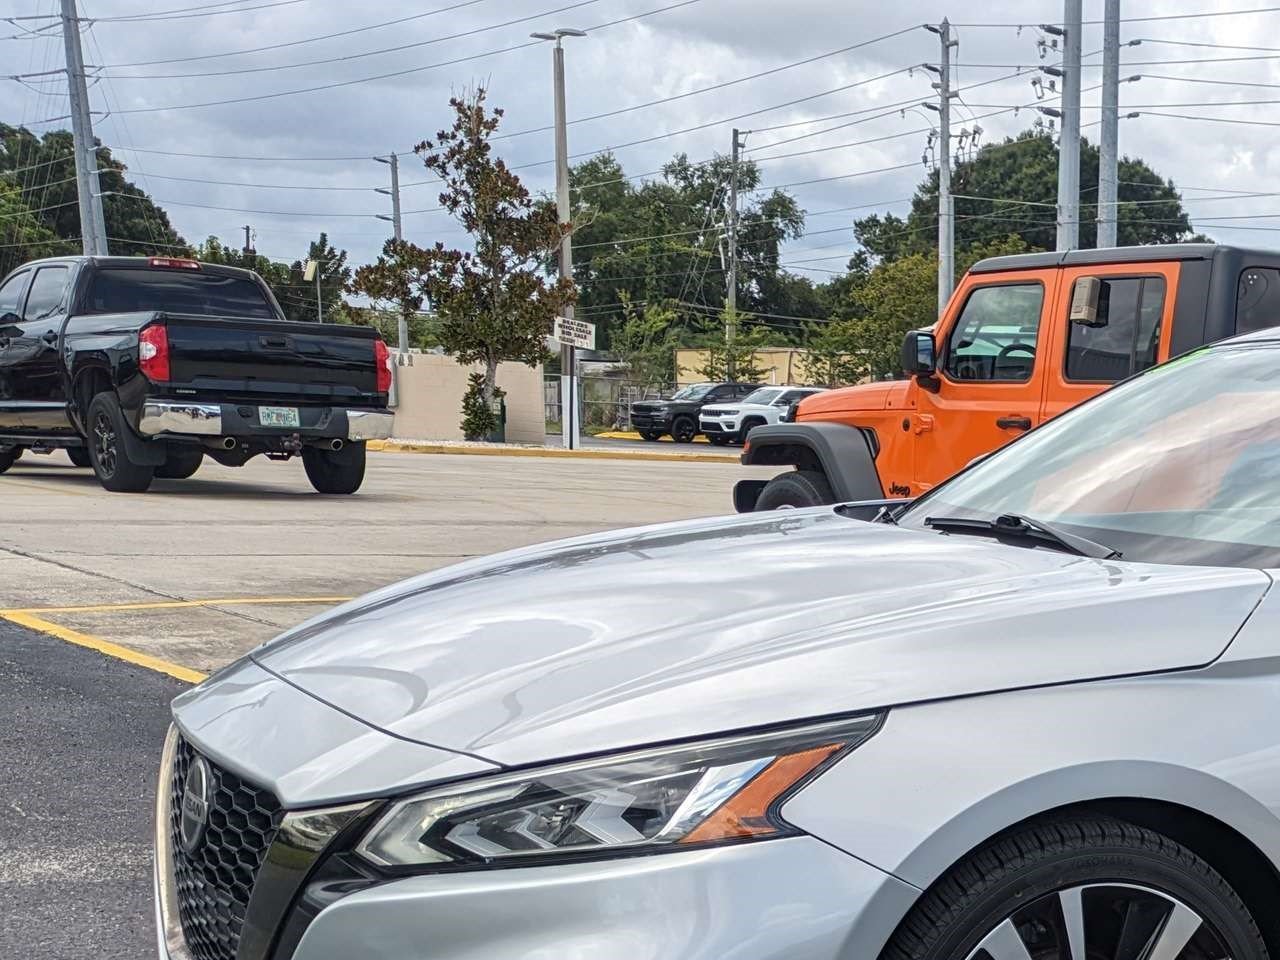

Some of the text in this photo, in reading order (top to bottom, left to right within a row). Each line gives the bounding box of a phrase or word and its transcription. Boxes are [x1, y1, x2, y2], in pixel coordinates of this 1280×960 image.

[557, 322, 592, 336] WHOLESALE
[574, 332, 587, 340] SALE
[889, 481, 911, 498] Jeep
